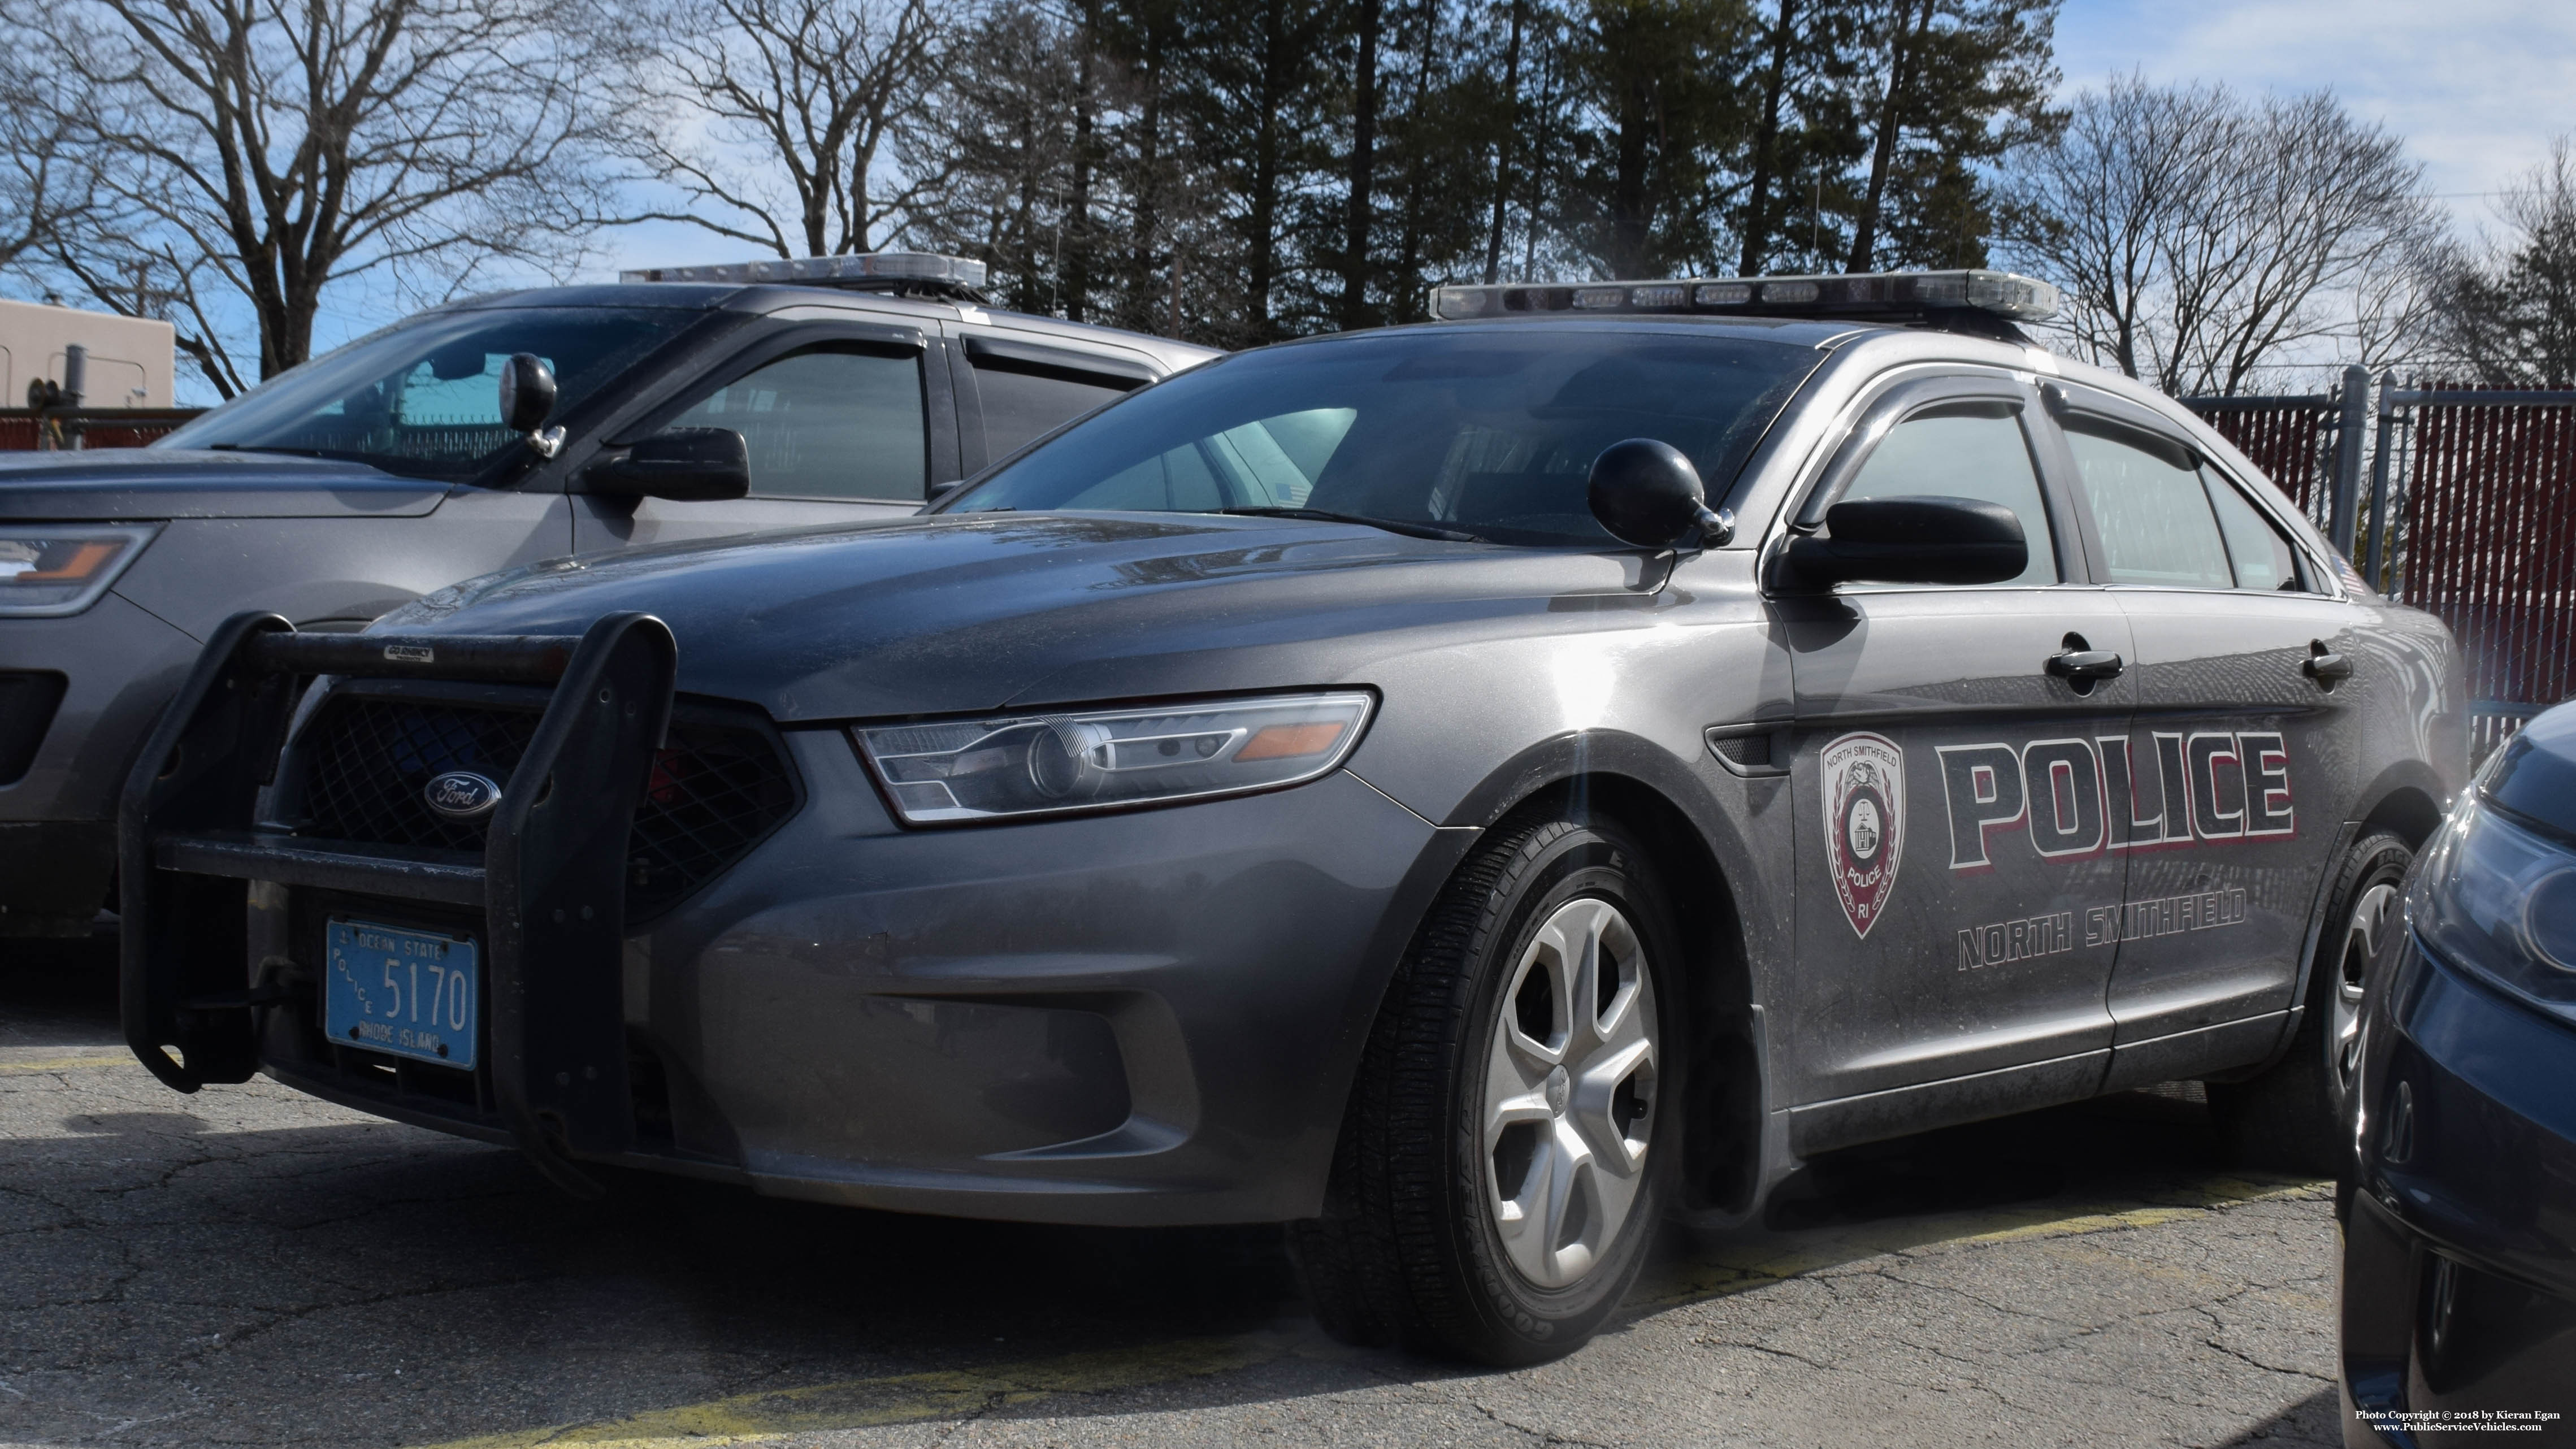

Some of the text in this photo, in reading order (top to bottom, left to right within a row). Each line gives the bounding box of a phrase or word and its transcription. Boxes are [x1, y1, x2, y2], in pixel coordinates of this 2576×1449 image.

[1827, 745, 1897, 770] NORTH SMITHFIELD
[437, 778, 479, 805] Ford
[1934, 731, 2296, 876] POLICE
[1847, 865, 1882, 888] POLICE
[1858, 903, 1869, 919] RI
[1958, 887, 2247, 971] NORTH SMITHFIELD
[358, 932, 441, 961] OCEAN STATE
[333, 948, 374, 1014] POLICE
[384, 957, 467, 1031] 5170
[358, 1021, 440, 1053] RHODE ISLAND
[1458, 1093, 1555, 1342] GOODYEAR
